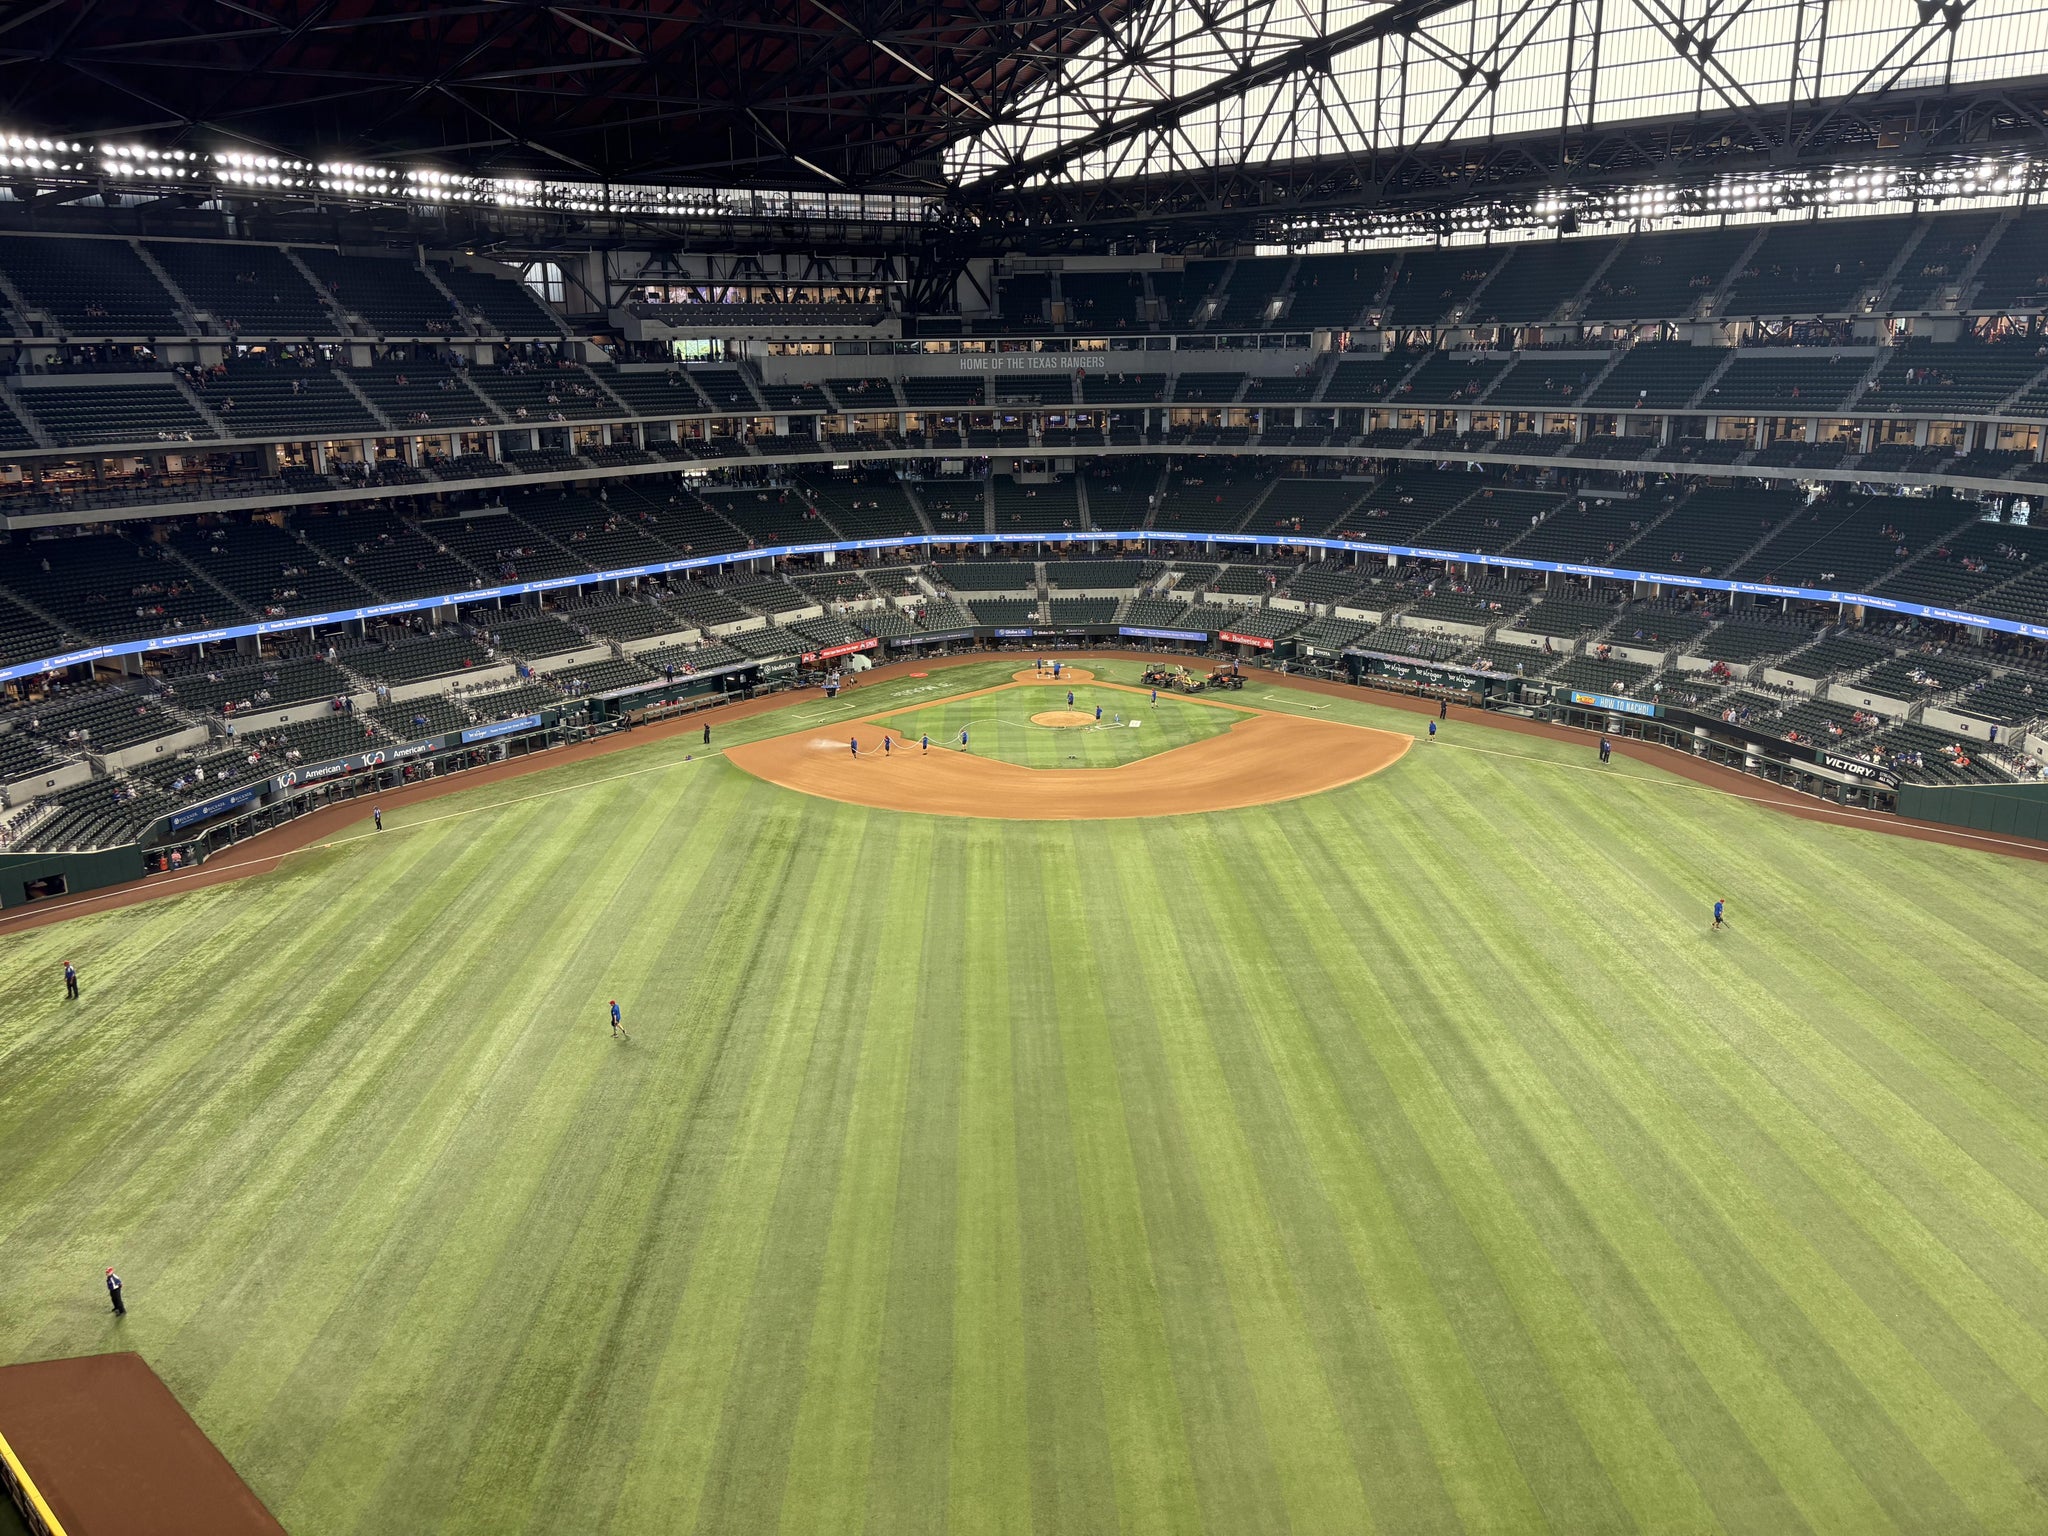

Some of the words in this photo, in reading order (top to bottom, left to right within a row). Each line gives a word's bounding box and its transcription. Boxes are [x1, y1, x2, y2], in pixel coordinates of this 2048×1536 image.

[961, 359, 988, 370] HOME
[991, 358, 1004, 370] OF
[1007, 358, 1024, 369] THE
[1028, 357, 1057, 369] TEXAS
[1061, 356, 1105, 368] RANGERS
[1231, 634, 1261, 647] Budweiser
[1314, 649, 1331, 657] TOYOTA
[771, 662, 788, 671] Medical
[788, 661, 796, 669] City
[1391, 663, 1410, 676] Kroger
[1423, 668, 1443, 682] Kroger
[1456, 674, 1476, 688] Kroger
[1600, 697, 1615, 710] HOW
[1617, 700, 1624, 710] TO
[1626, 701, 1649, 715] NACHO!
[361, 750, 385, 767] 100
[393, 745, 426, 758] American
[305, 765, 341, 779] American
[1825, 756, 1873, 777] VICTORY
[276, 772, 297, 789] 100
